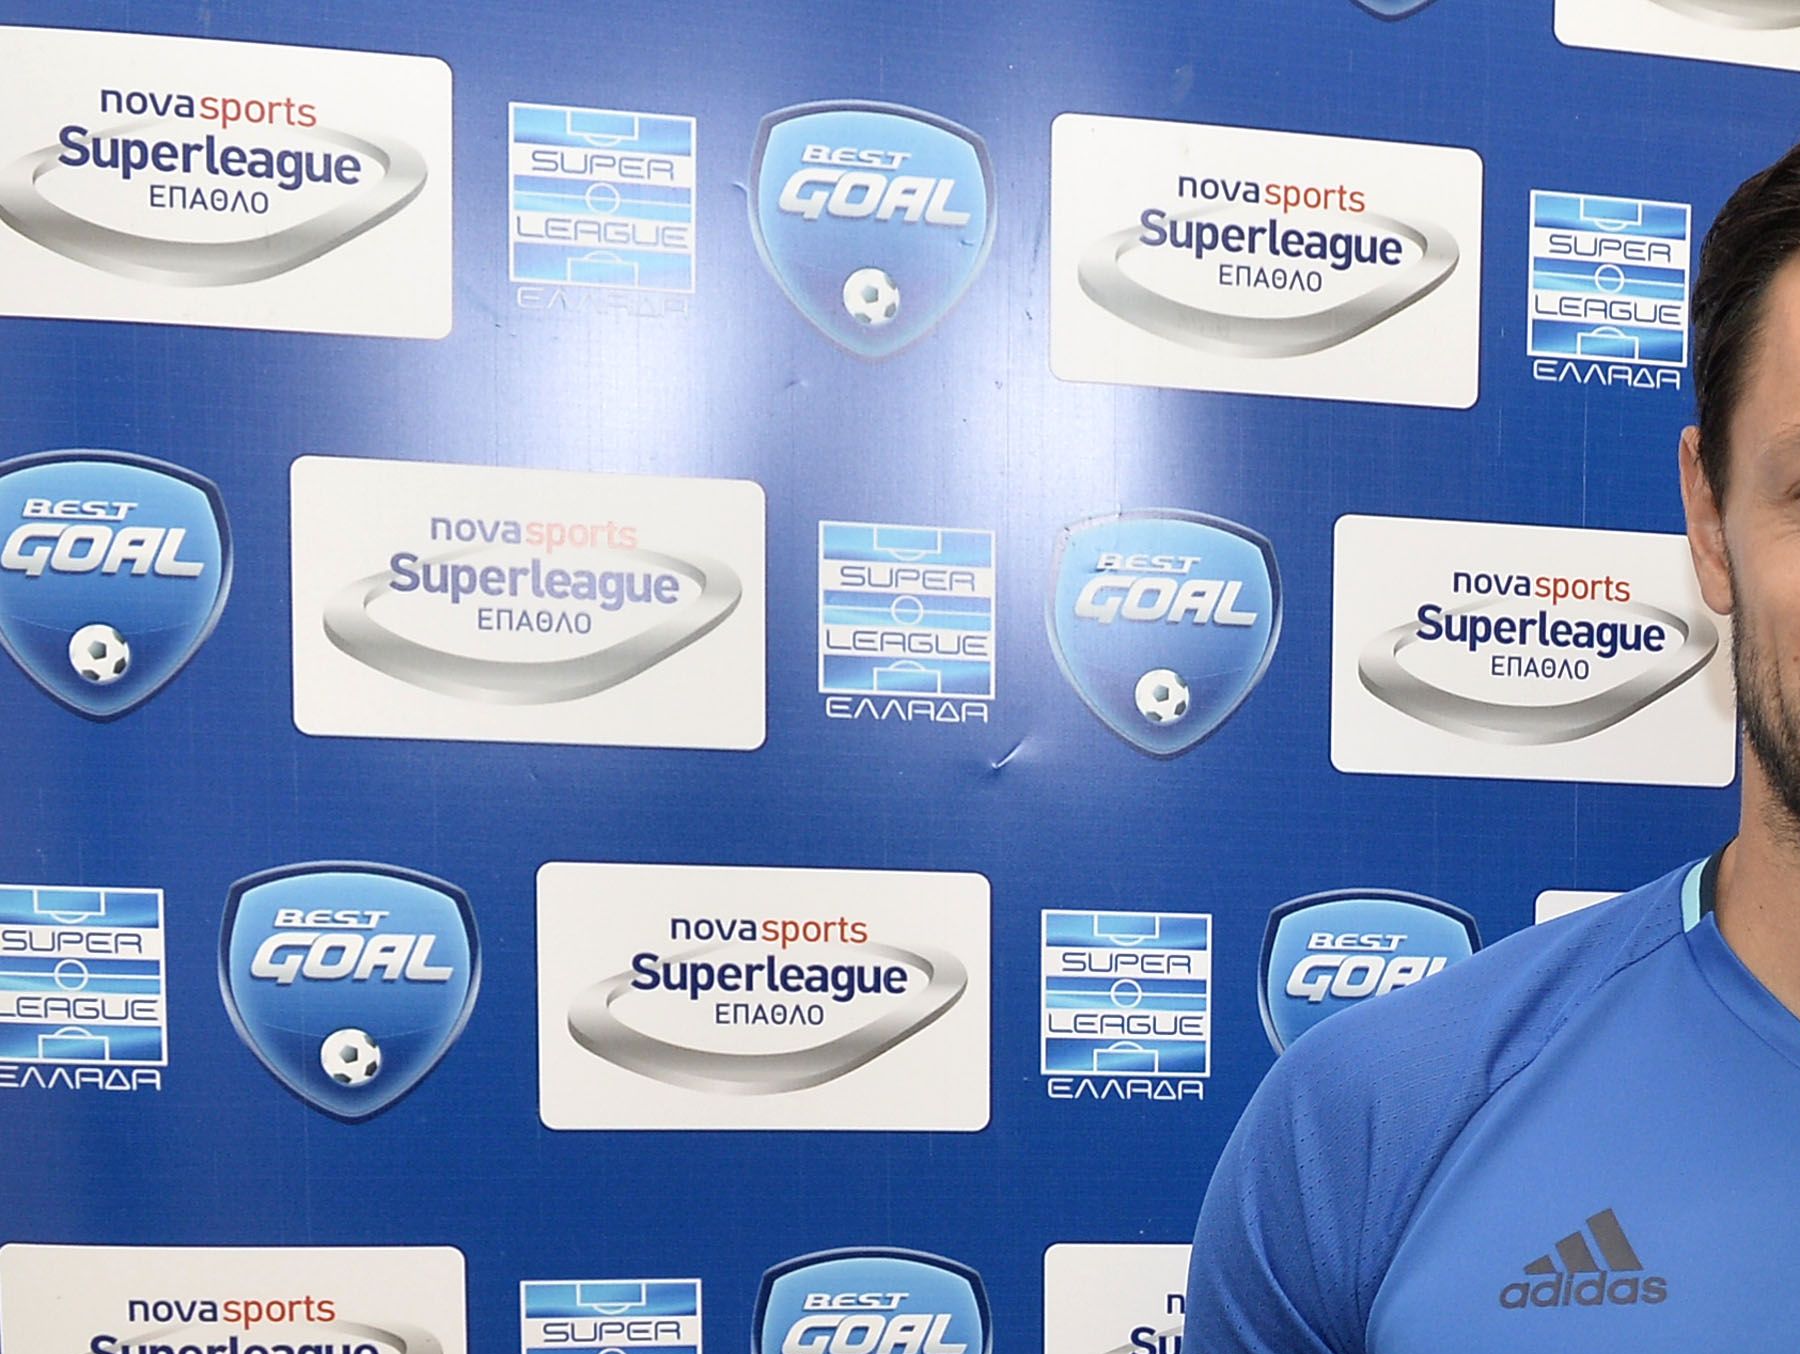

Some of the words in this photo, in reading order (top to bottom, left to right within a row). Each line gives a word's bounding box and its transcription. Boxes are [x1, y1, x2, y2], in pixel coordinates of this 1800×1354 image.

[102, 90, 316, 129] novasports
[59, 126, 360, 190] Superleague
[150, 185, 268, 214] ΕΠΑΘΛΟ
[779, 167, 970, 225] GOAL
[1179, 177, 1365, 213] novasports
[1140, 210, 1402, 270] Superleague
[1550, 234, 1670, 262] SUPER
[1220, 264, 1321, 292] ΕΠΑΘΛΟ
[1535, 295, 1681, 325] LEAGUE
[0, 521, 205, 576] GOAL
[431, 518, 639, 553] novasports
[389, 553, 679, 610] Superleague
[841, 566, 974, 591] SUPER
[1454, 573, 1630, 605] novasports
[1075, 574, 1257, 624] GOAL
[478, 608, 591, 634] ΕΠΑΘΛΟ
[1417, 605, 1665, 658] Superleague
[827, 630, 987, 656] LEAGUE
[1492, 656, 1588, 679] ΕΠΑΘΛΟ
[274, 908, 390, 928] BEST
[672, 918, 867, 949] novasports
[251, 930, 454, 982] GOAL
[1063, 953, 1191, 973] SUPER
[632, 953, 907, 1002] Superleague
[716, 1004, 823, 1025] ΕΠΑΘΛΟ
[1049, 1014, 1203, 1035] LEAGUE
[1499, 1270, 1668, 1309] adidas
[129, 1296, 335, 1330] novasports
[543, 1321, 680, 1342] SUPER
